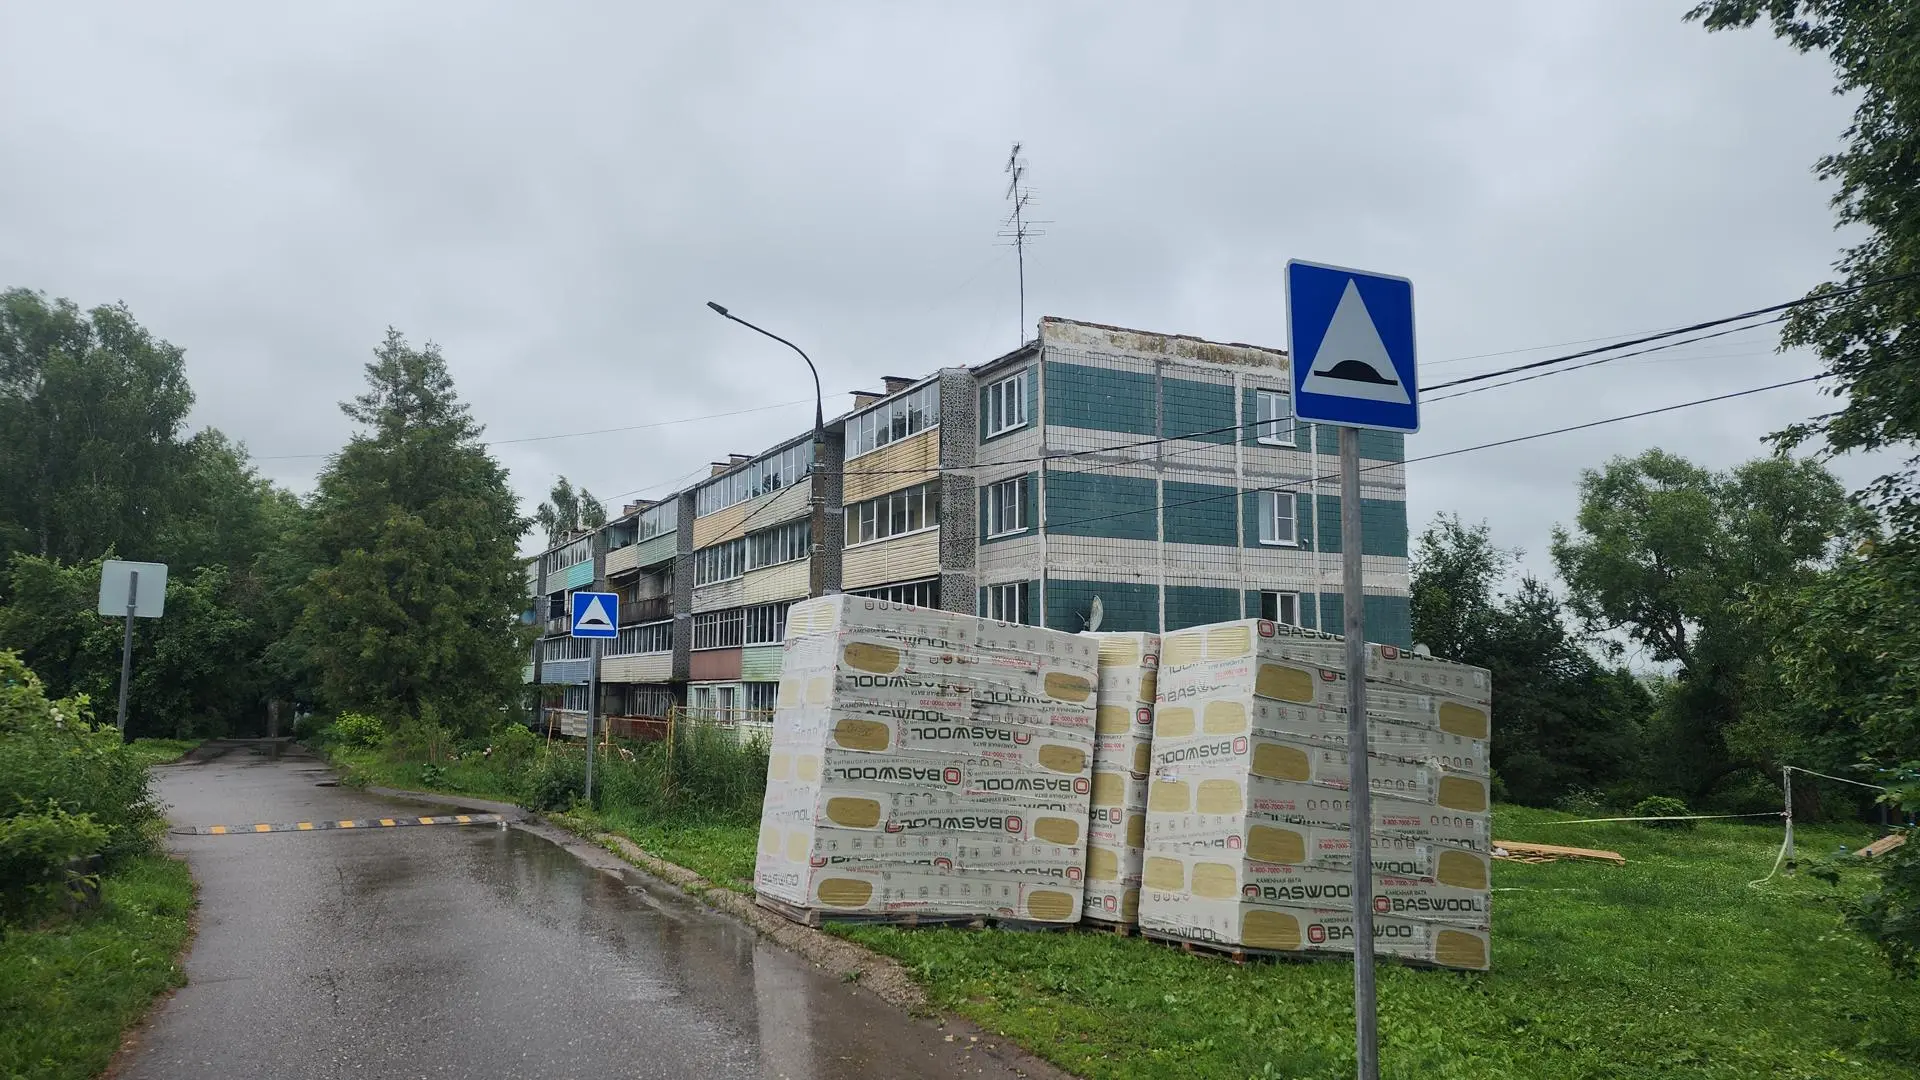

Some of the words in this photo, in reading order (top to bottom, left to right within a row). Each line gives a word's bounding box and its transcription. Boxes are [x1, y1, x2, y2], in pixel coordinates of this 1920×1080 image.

[911, 727, 1011, 741] BASWOOL
[1158, 742, 1231, 764] BASWOOL
[834, 767, 940, 781] BASWOOL
[975, 778, 1071, 791] BASWOOL
[1263, 885, 1353, 900] BASWOO
[1392, 898, 1482, 912] BASWOOL
